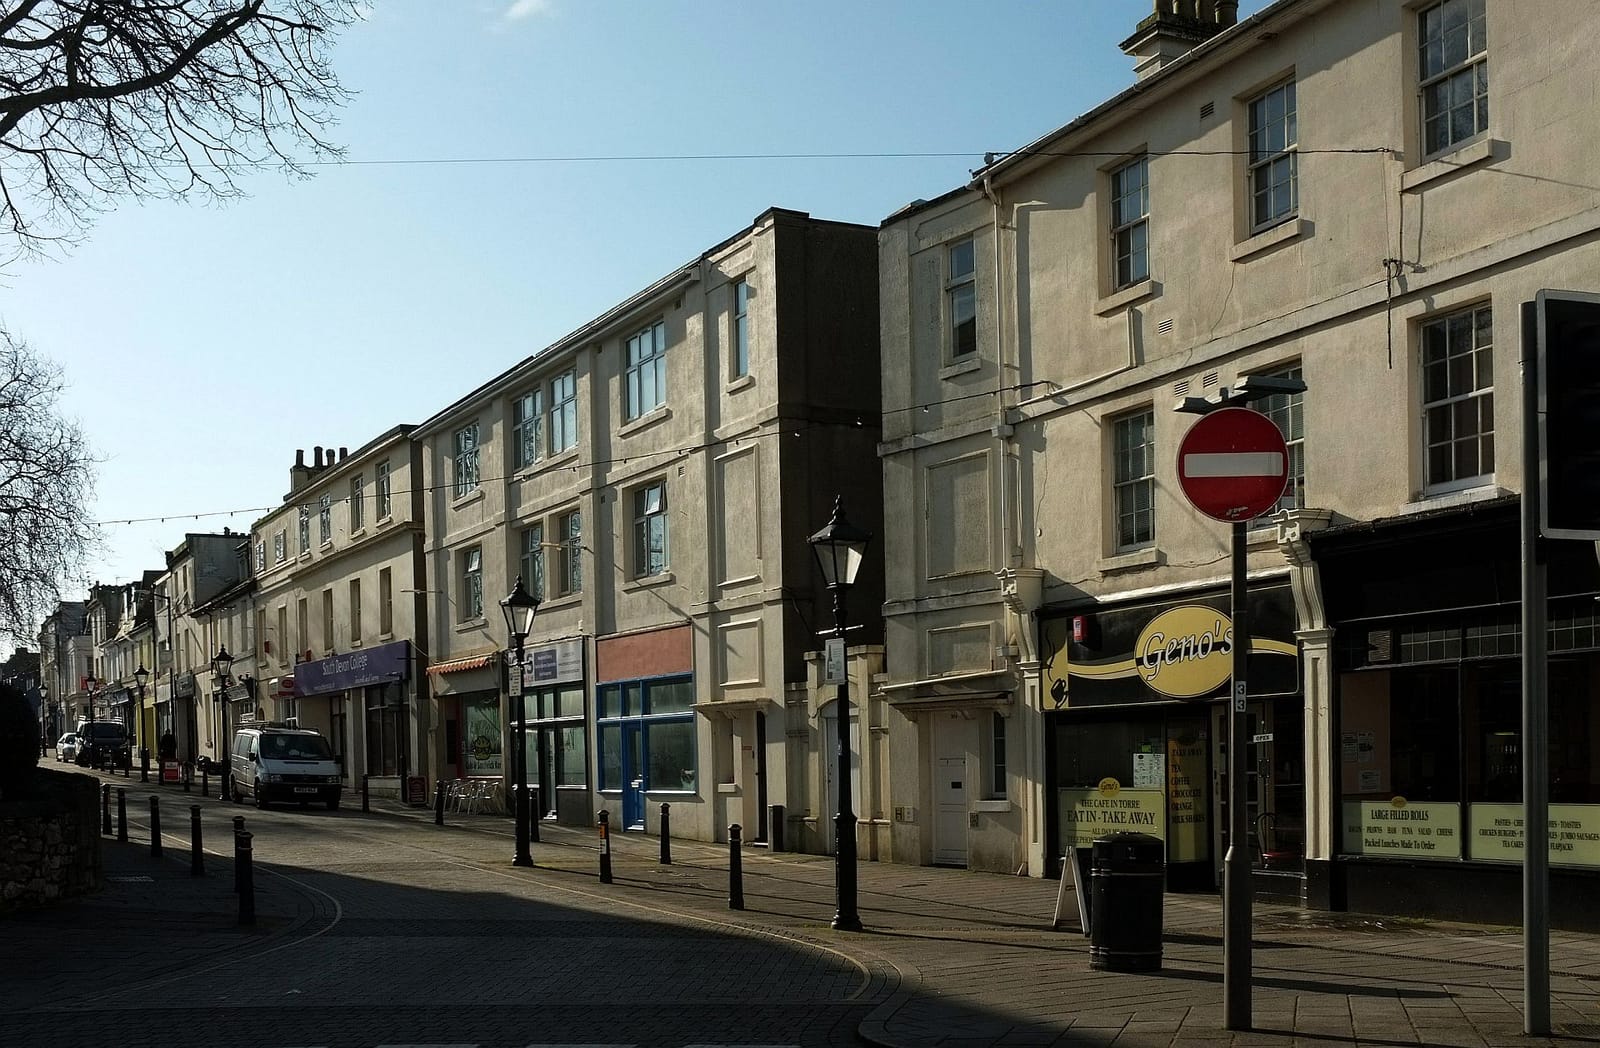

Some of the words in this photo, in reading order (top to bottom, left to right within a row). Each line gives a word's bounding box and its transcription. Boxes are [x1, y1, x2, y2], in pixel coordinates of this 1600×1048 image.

[1143, 620, 1232, 682] Geno's
[322, 662, 336, 676] South
[335, 659, 350, 673] Devon
[350, 655, 368, 671] College
[1100, 781, 1118, 793] Geno's
[1081, 800, 1093, 808] THE
[1094, 800, 1109, 808] CAFE
[1110, 800, 1118, 808] IN
[1119, 800, 1140, 809] TORRE
[1171, 802, 1192, 811] ORANGE
[1067, 810, 1085, 822] EAT
[1086, 811, 1096, 822] IN
[1102, 811, 1127, 824] TAKE
[1129, 812, 1155, 825] AWAY
[1371, 809, 1389, 820] LARGE
[1390, 810, 1409, 820] FILLED
[1410, 810, 1429, 821] ROLLS
[1365, 838, 1380, 847] Packed
[1381, 839, 1400, 848] Lunches
[1400, 839, 1413, 848] Made
[1414, 840, 1420, 849] To
[1420, 840, 1436, 850] Order
